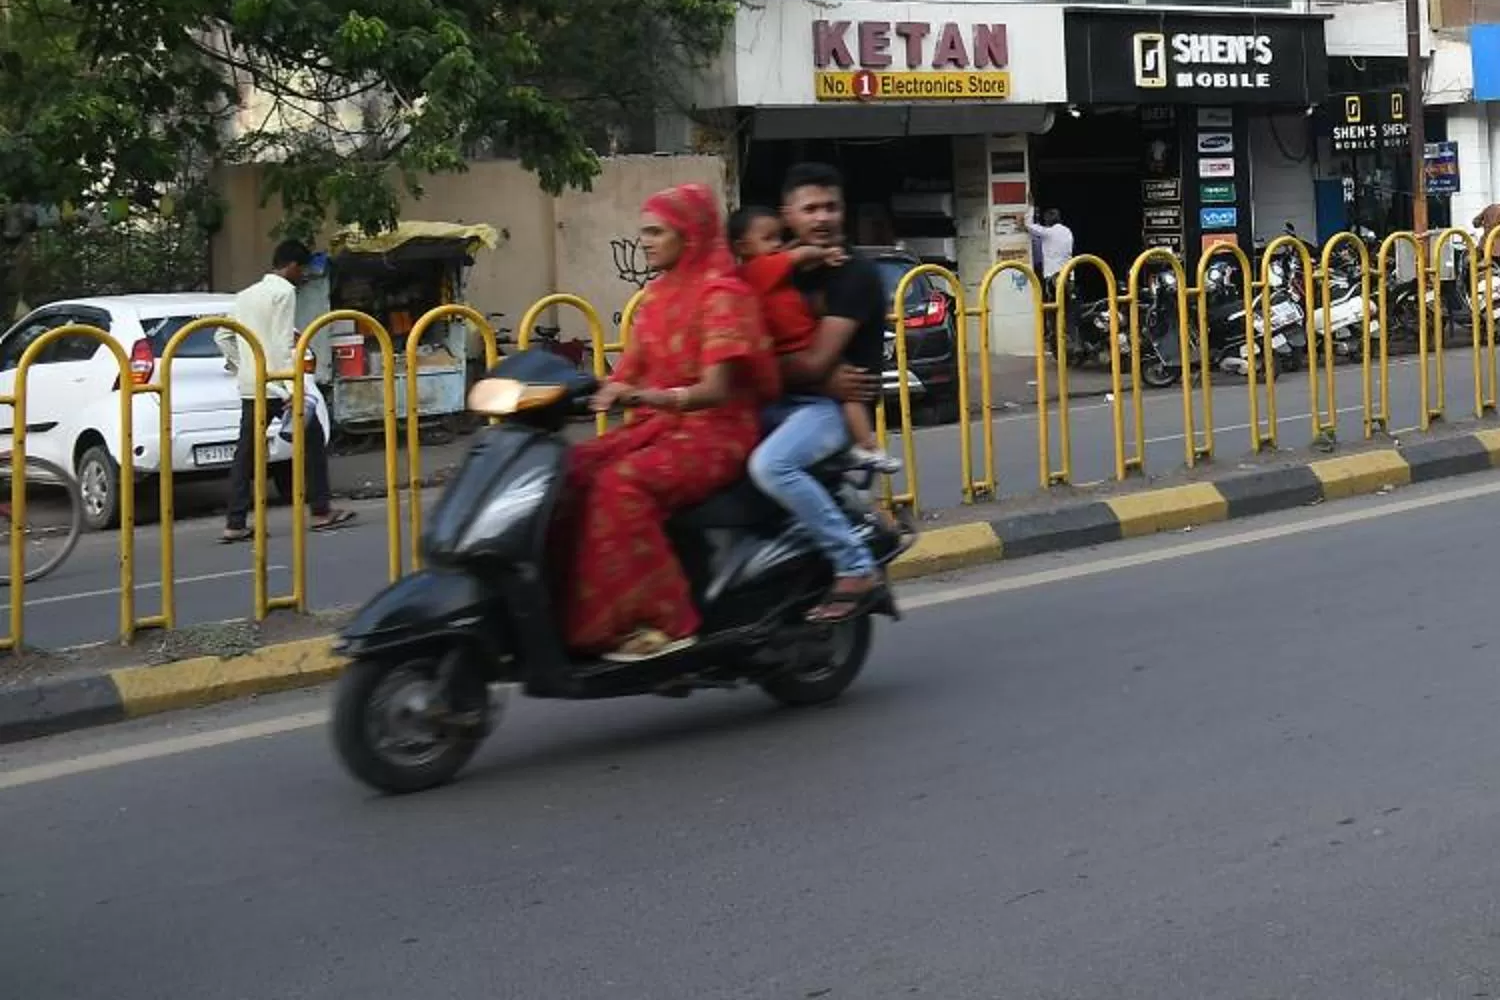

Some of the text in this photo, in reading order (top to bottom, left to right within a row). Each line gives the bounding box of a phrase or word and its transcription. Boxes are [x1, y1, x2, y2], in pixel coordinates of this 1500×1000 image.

[812, 19, 1009, 69] KETAN
[1171, 33, 1273, 65] SHEN'S
[823, 74, 1005, 96] No. 1 Electronics Store
[1176, 72, 1271, 88] MOBILE
[1333, 124, 1377, 139] SHEN'S
